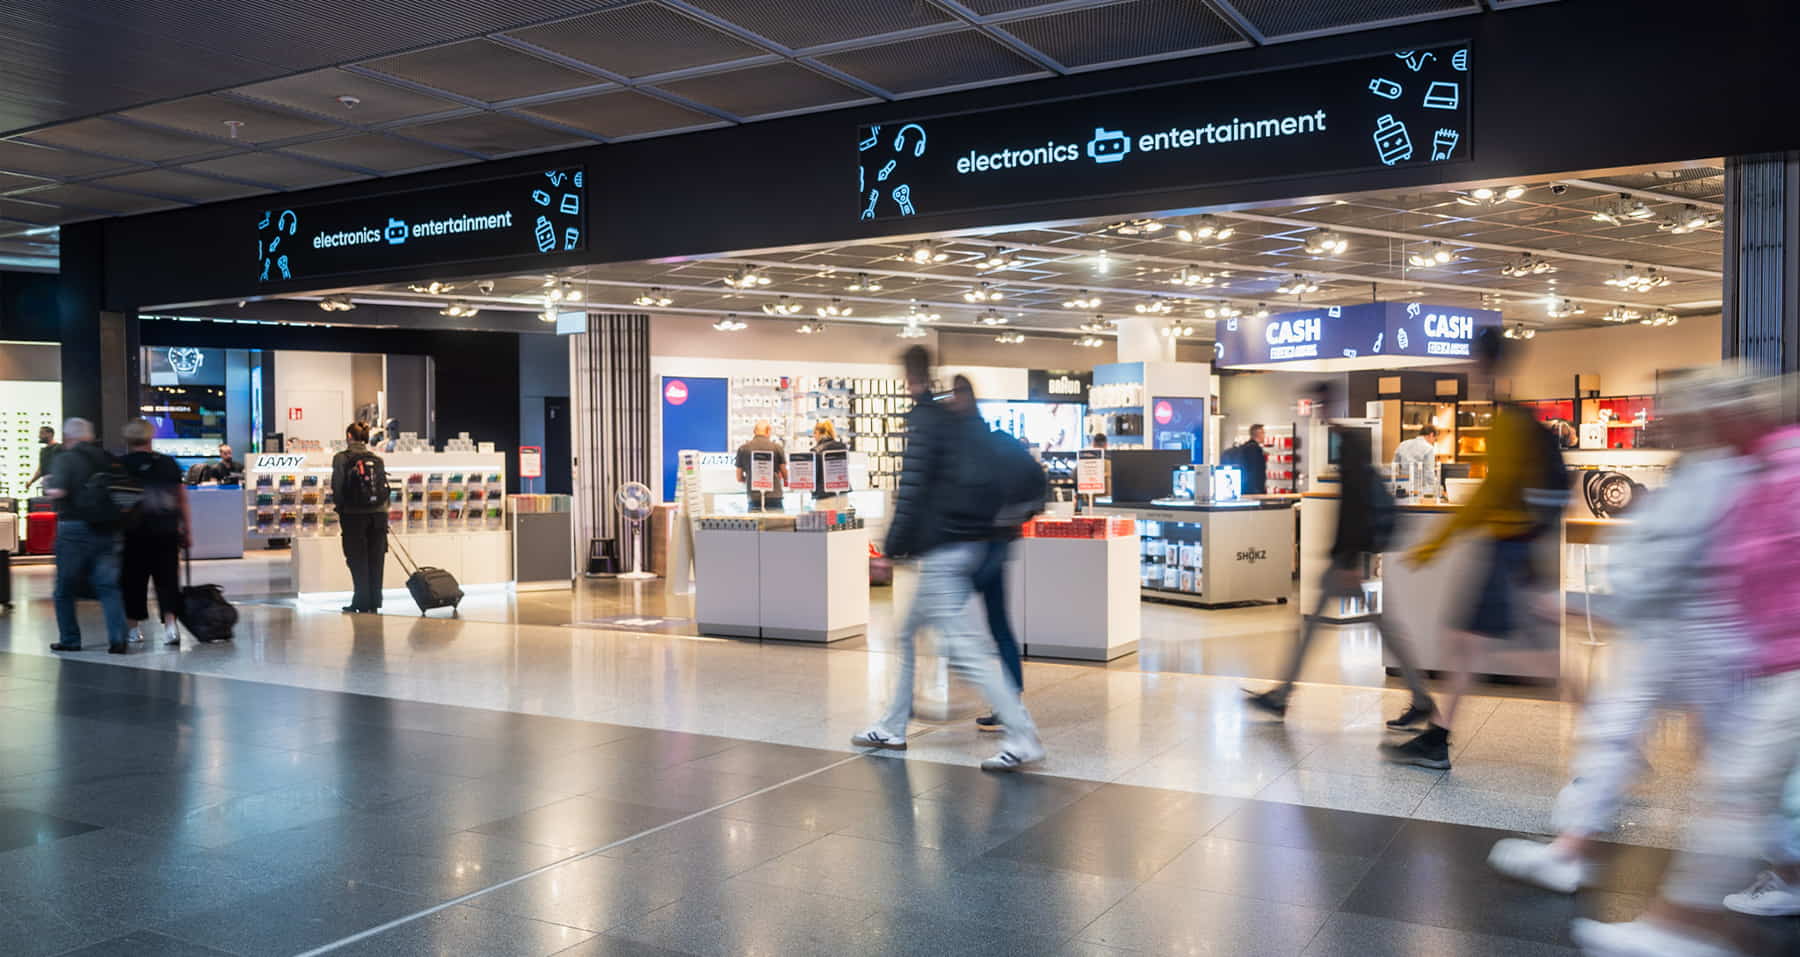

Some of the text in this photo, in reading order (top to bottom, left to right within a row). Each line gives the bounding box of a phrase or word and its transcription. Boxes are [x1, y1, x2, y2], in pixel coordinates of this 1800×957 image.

[956, 109, 1327, 174] electronics entertainment
[313, 210, 513, 249] electronics entertainment
[1265, 318, 1321, 345] CASH
[1424, 313, 1473, 340] CASH
[257, 456, 304, 468] LAMY
[1236, 549, 1267, 563] SHOKZ
